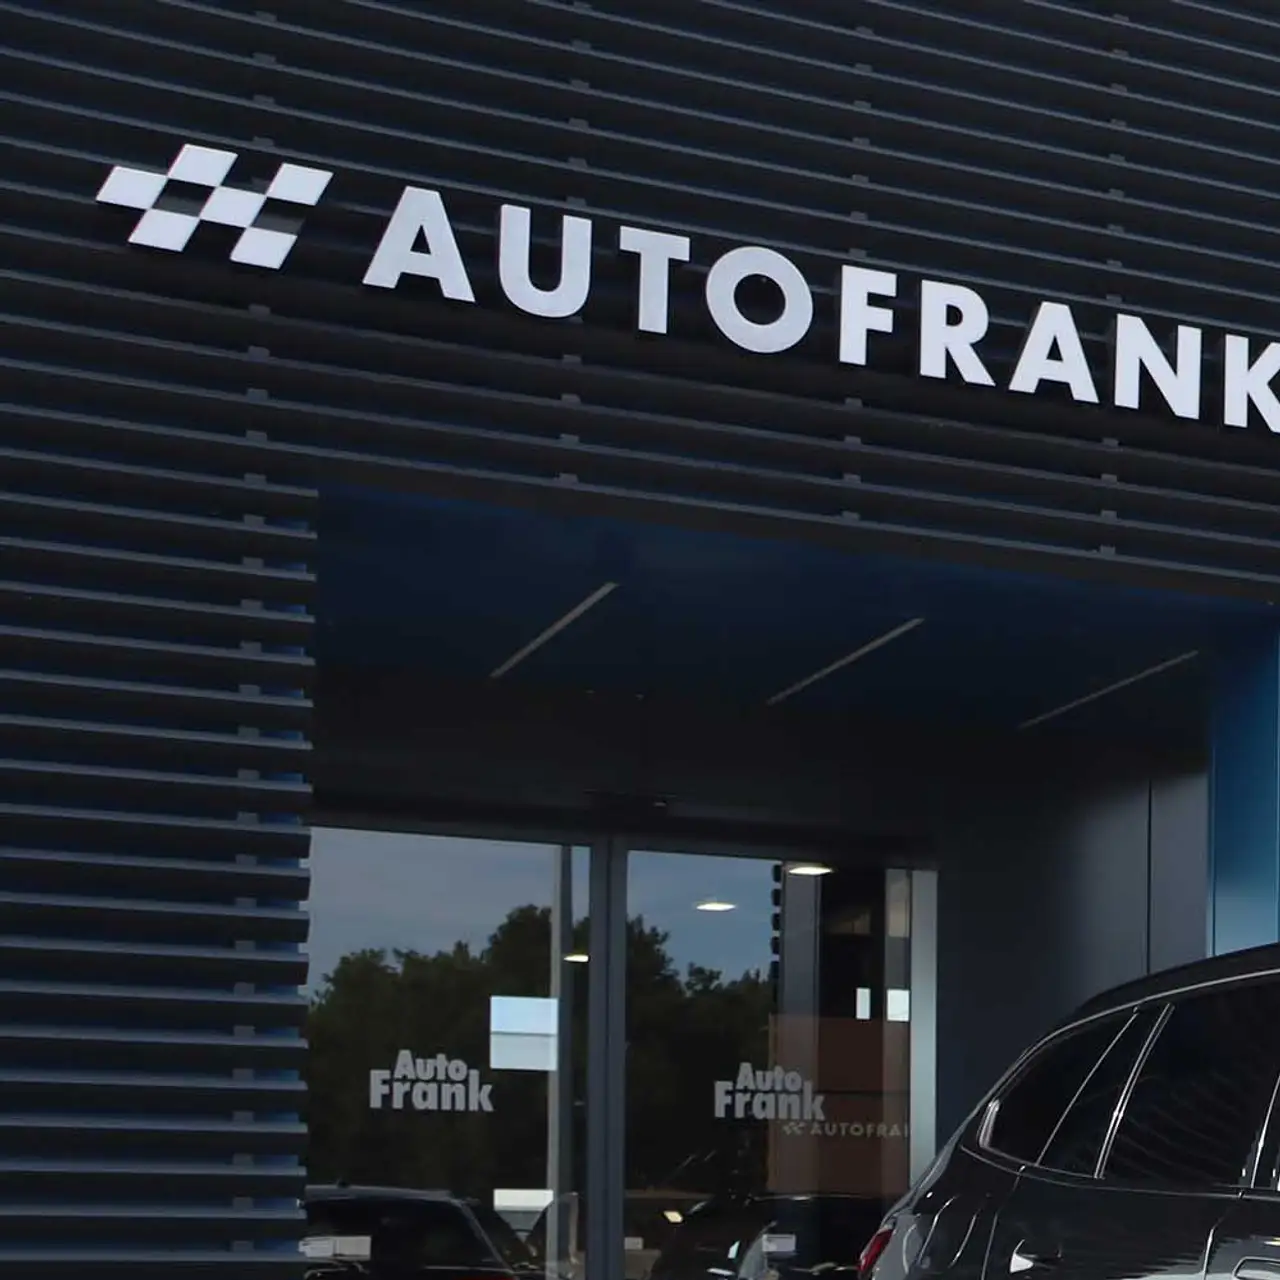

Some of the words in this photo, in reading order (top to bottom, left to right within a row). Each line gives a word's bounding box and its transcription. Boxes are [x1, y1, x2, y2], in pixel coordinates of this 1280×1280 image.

[394, 1049, 468, 1081] Auto
[736, 1061, 802, 1091] Auto
[369, 1069, 494, 1112] Frank
[714, 1080, 826, 1120] Frank
